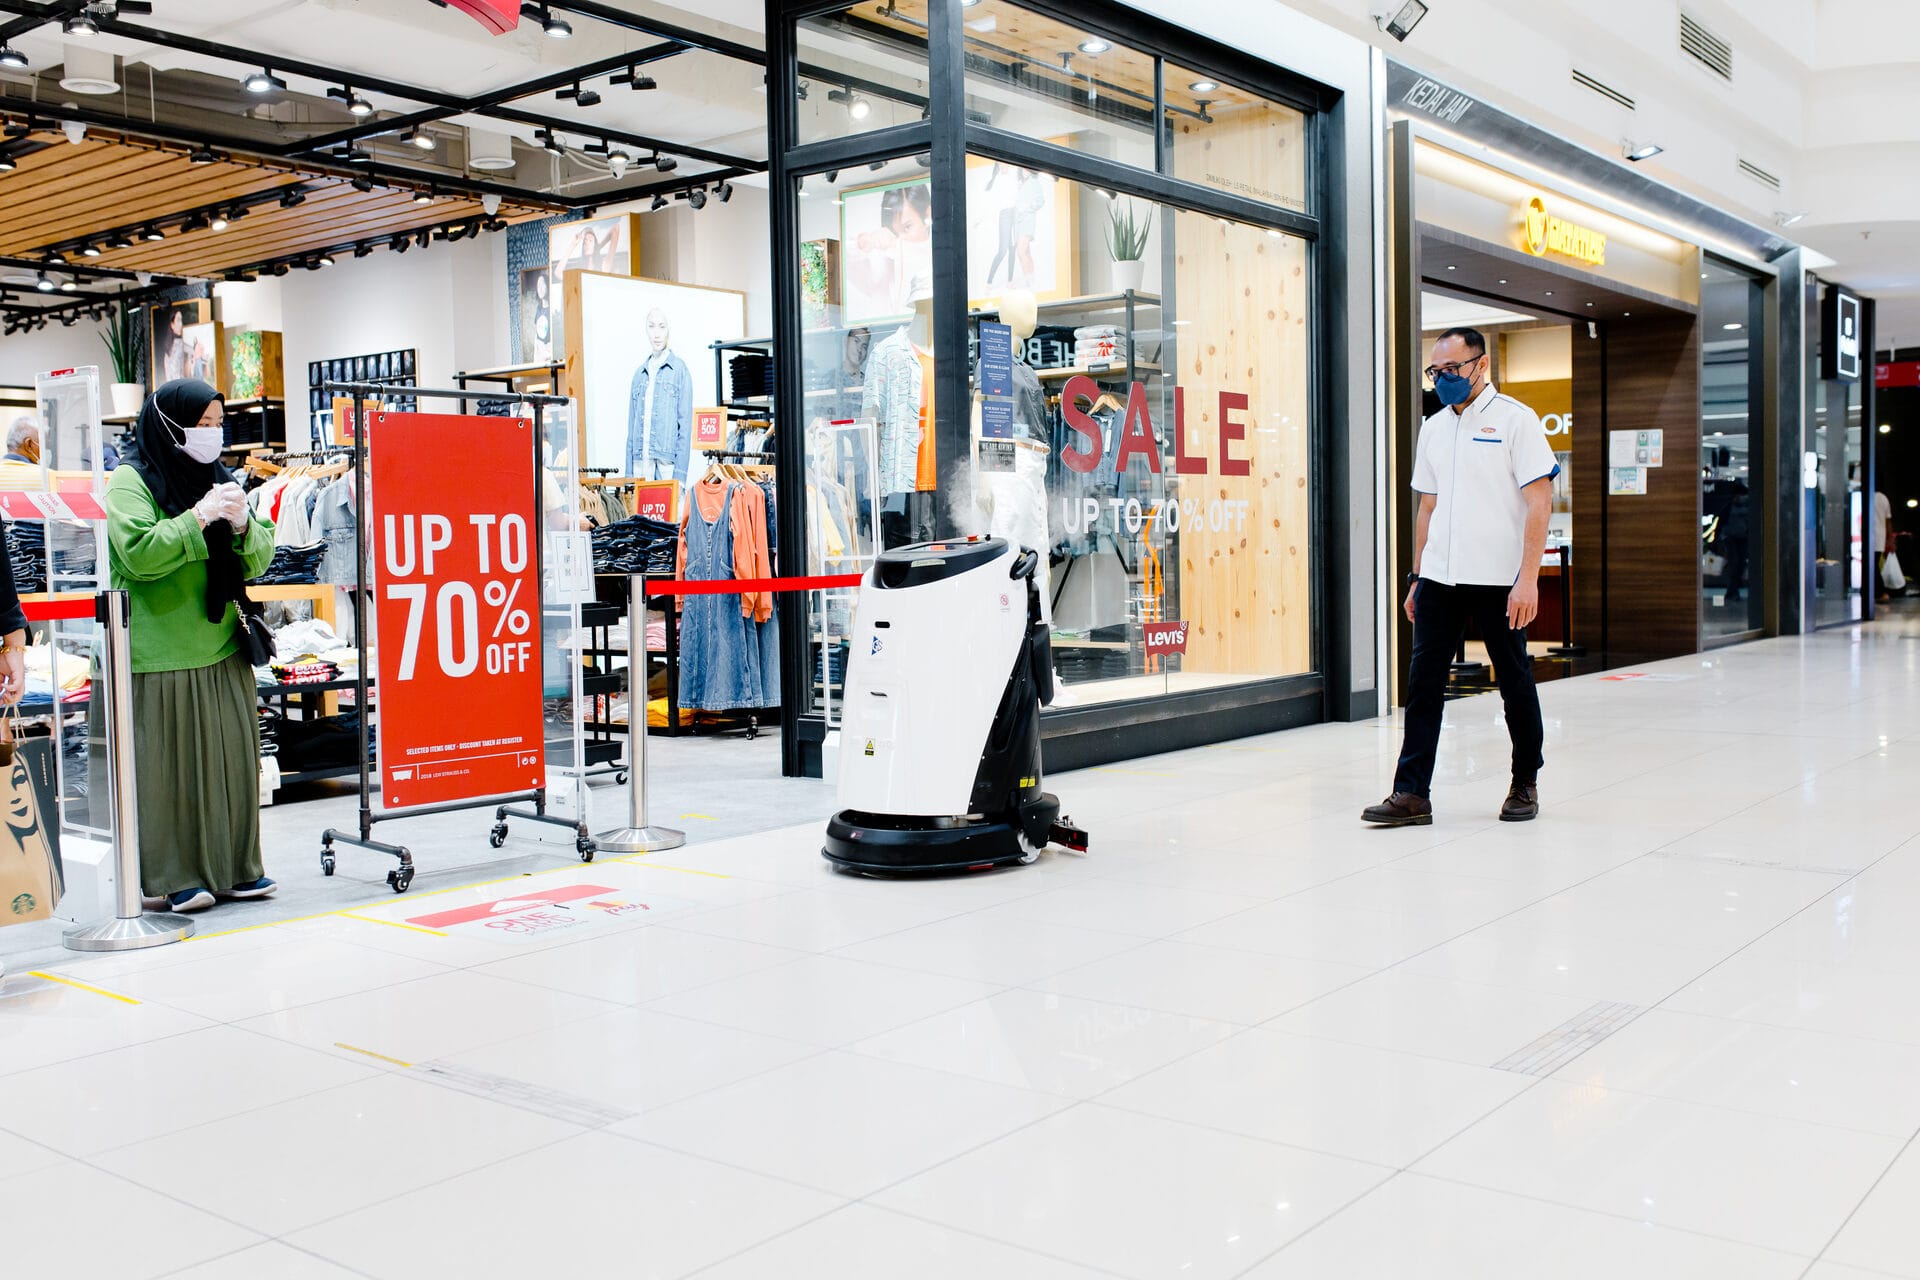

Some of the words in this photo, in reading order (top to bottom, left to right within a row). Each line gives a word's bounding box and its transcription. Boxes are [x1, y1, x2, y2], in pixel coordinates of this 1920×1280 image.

[1401, 77, 1451, 114] KEDAI
[1436, 93, 1474, 124] JAM
[1060, 375, 1250, 476] SALE
[642, 503, 654, 514] UP
[655, 503, 666, 514] TO
[1063, 497, 1100, 534] UP
[1109, 498, 1143, 534] TO
[1151, 499, 1204, 534] 70%
[1209, 500, 1249, 533] OFF
[384, 514, 453, 577] UP
[469, 513, 528, 574] TO
[386, 578, 531, 681] 70%
[485, 641, 532, 675] OFF
[406, 746, 429, 756] SELECTED
[429, 744, 444, 753] ITEMS
[444, 743, 456, 752] ONLY
[459, 740, 482, 750] DISCOUNT
[482, 739, 495, 747] TAKEN
[495, 738, 502, 746] AT
[501, 736, 523, 745] REGISTER
